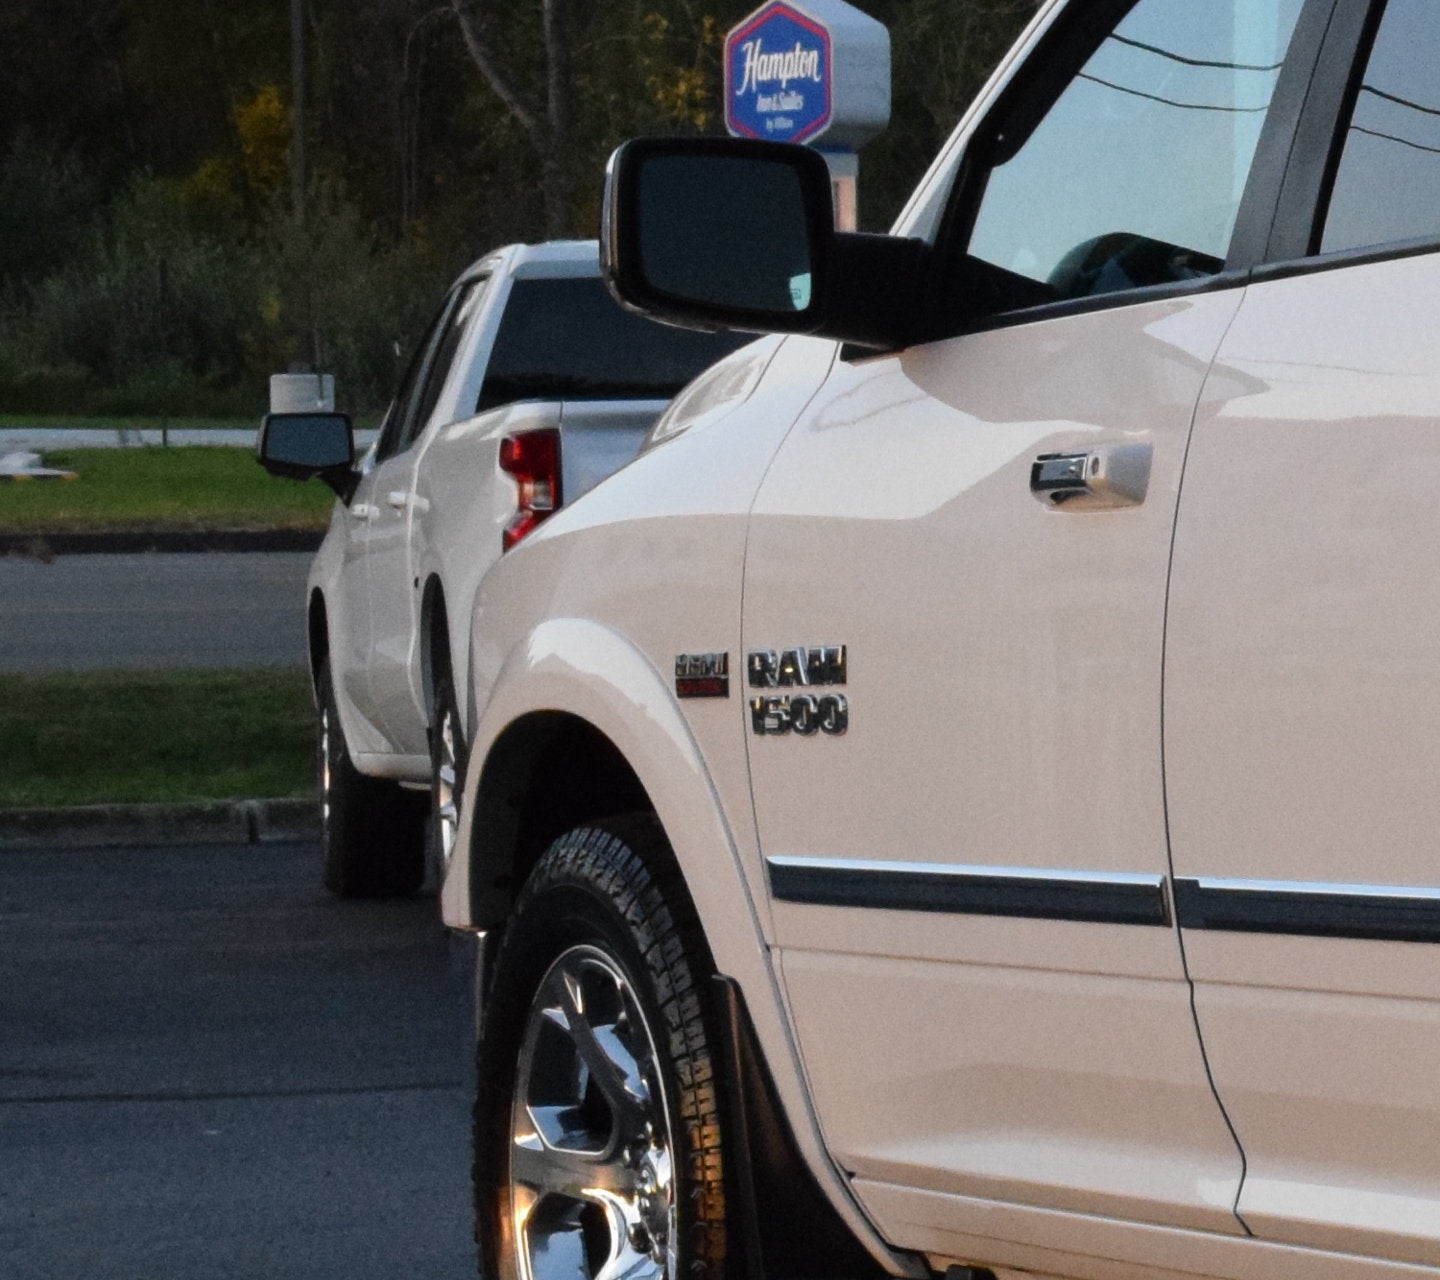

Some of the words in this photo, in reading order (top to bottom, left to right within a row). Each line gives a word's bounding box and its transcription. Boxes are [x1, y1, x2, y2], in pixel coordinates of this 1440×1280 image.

[735, 38, 822, 96] Hampton
[748, 645, 847, 687] RAM
[750, 693, 848, 735] 1500
